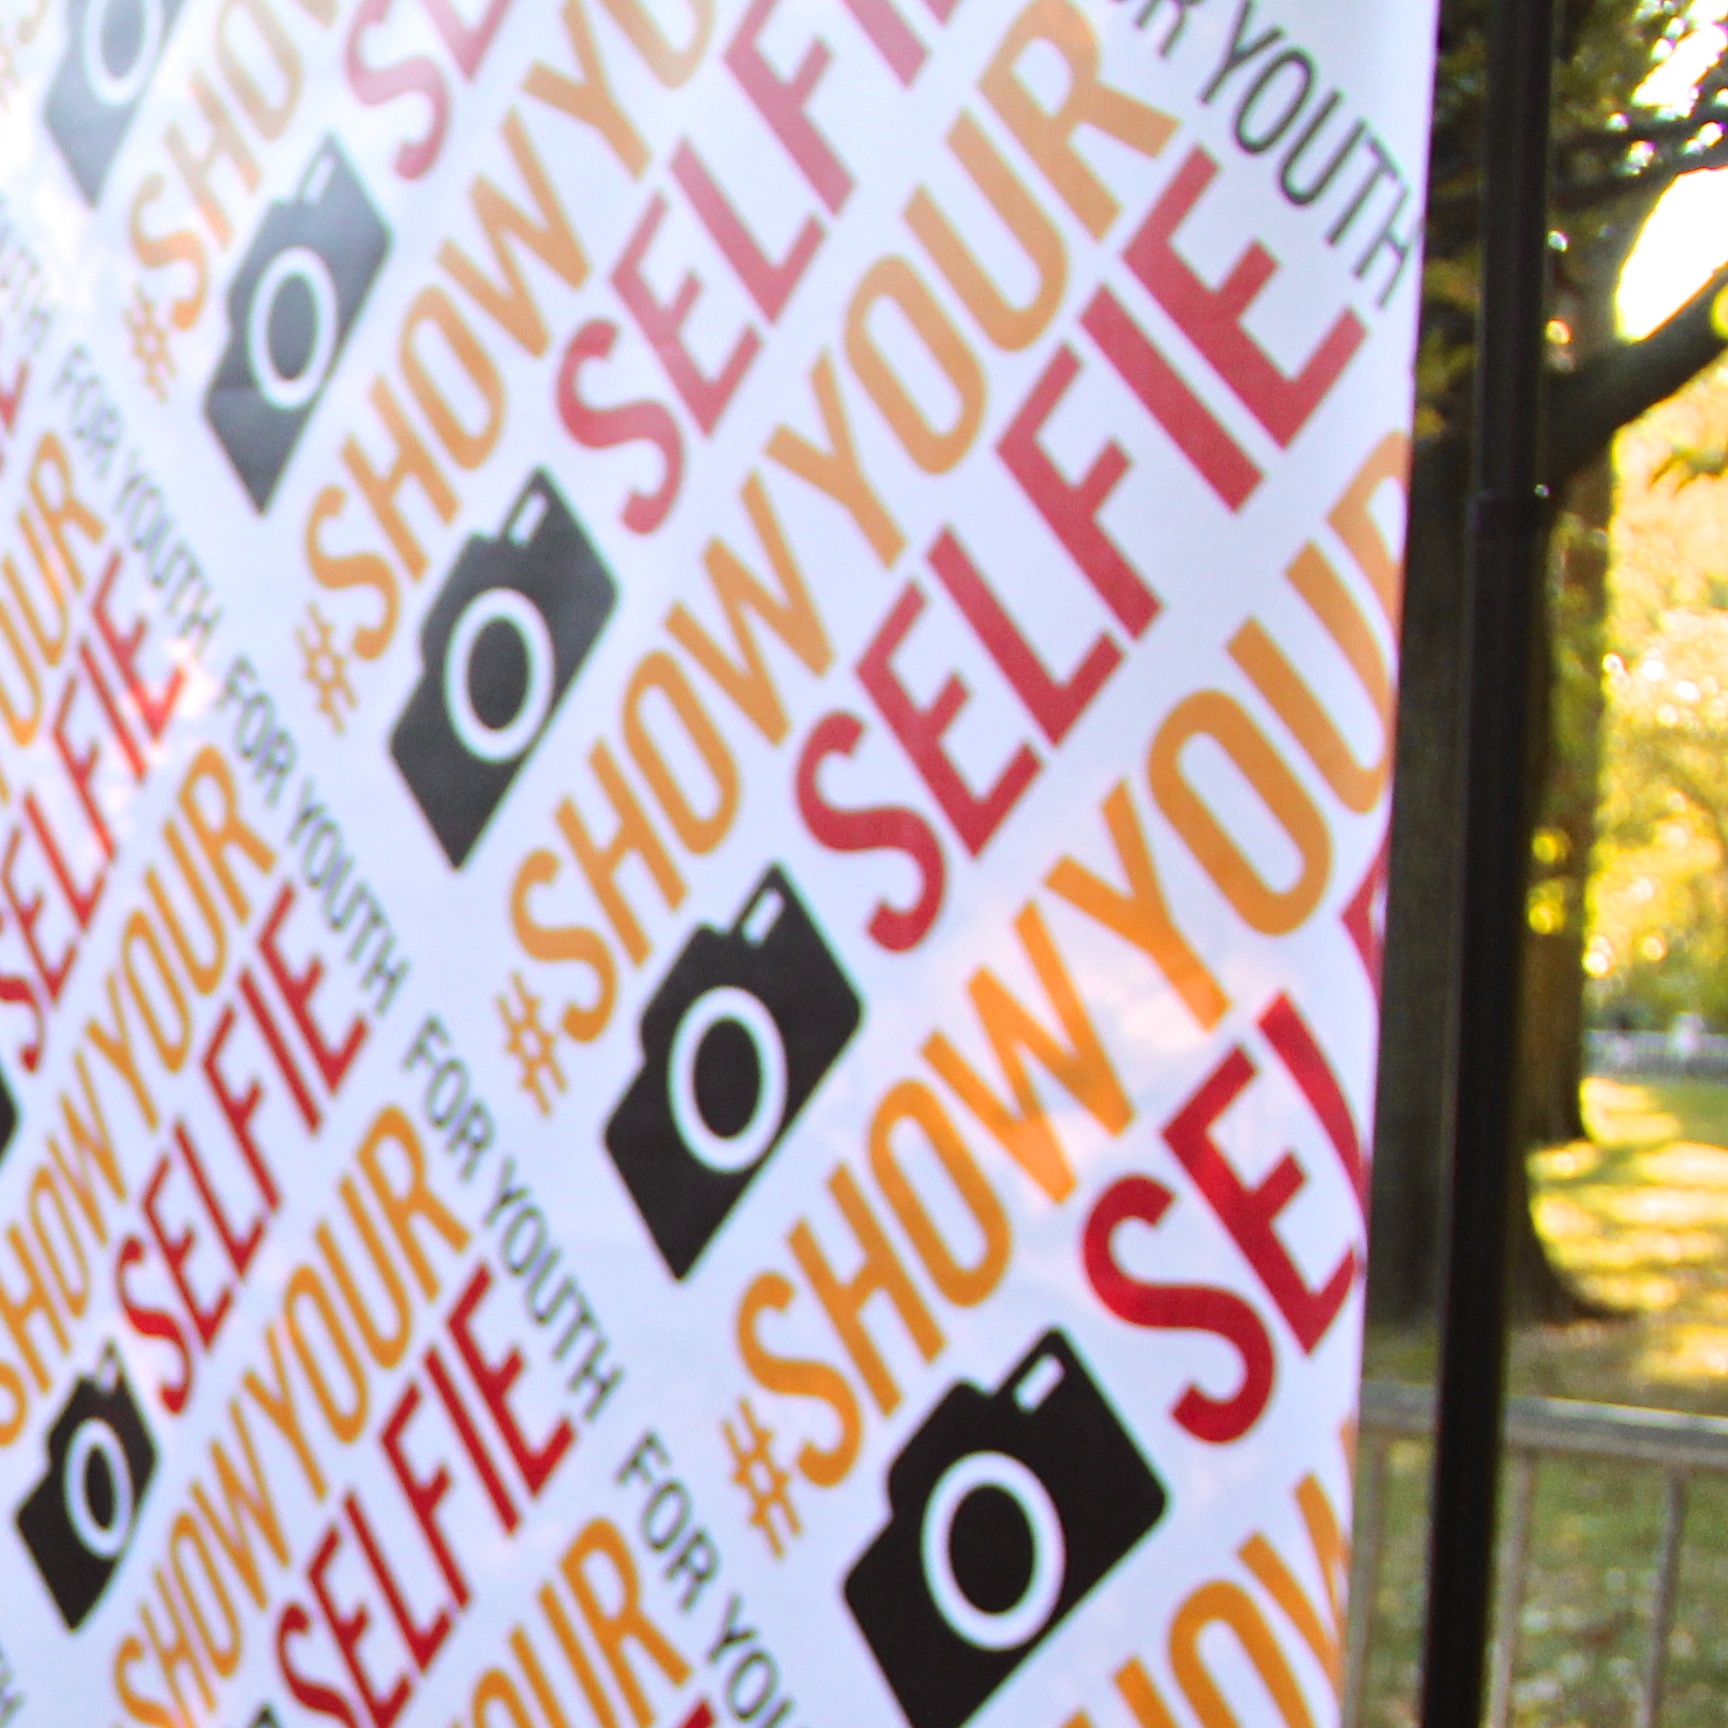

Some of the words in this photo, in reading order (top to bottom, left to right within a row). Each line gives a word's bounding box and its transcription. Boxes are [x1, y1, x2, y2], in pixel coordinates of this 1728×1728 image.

[1201, 0, 1417, 312] YOUTH
[108, 458, 221, 655] YOUTH
[498, 0, 1180, 1118] #SHOWYOUR
[795, 144, 1370, 952] SELFIE
[216, 654, 299, 808] FOR
[282, 780, 412, 1014] YOUTH
[117, 882, 369, 1413] SELFIE
[402, 1016, 495, 1183] FOR
[481, 1158, 625, 1422] YOUTH
[615, 1429, 720, 1613] FOR
